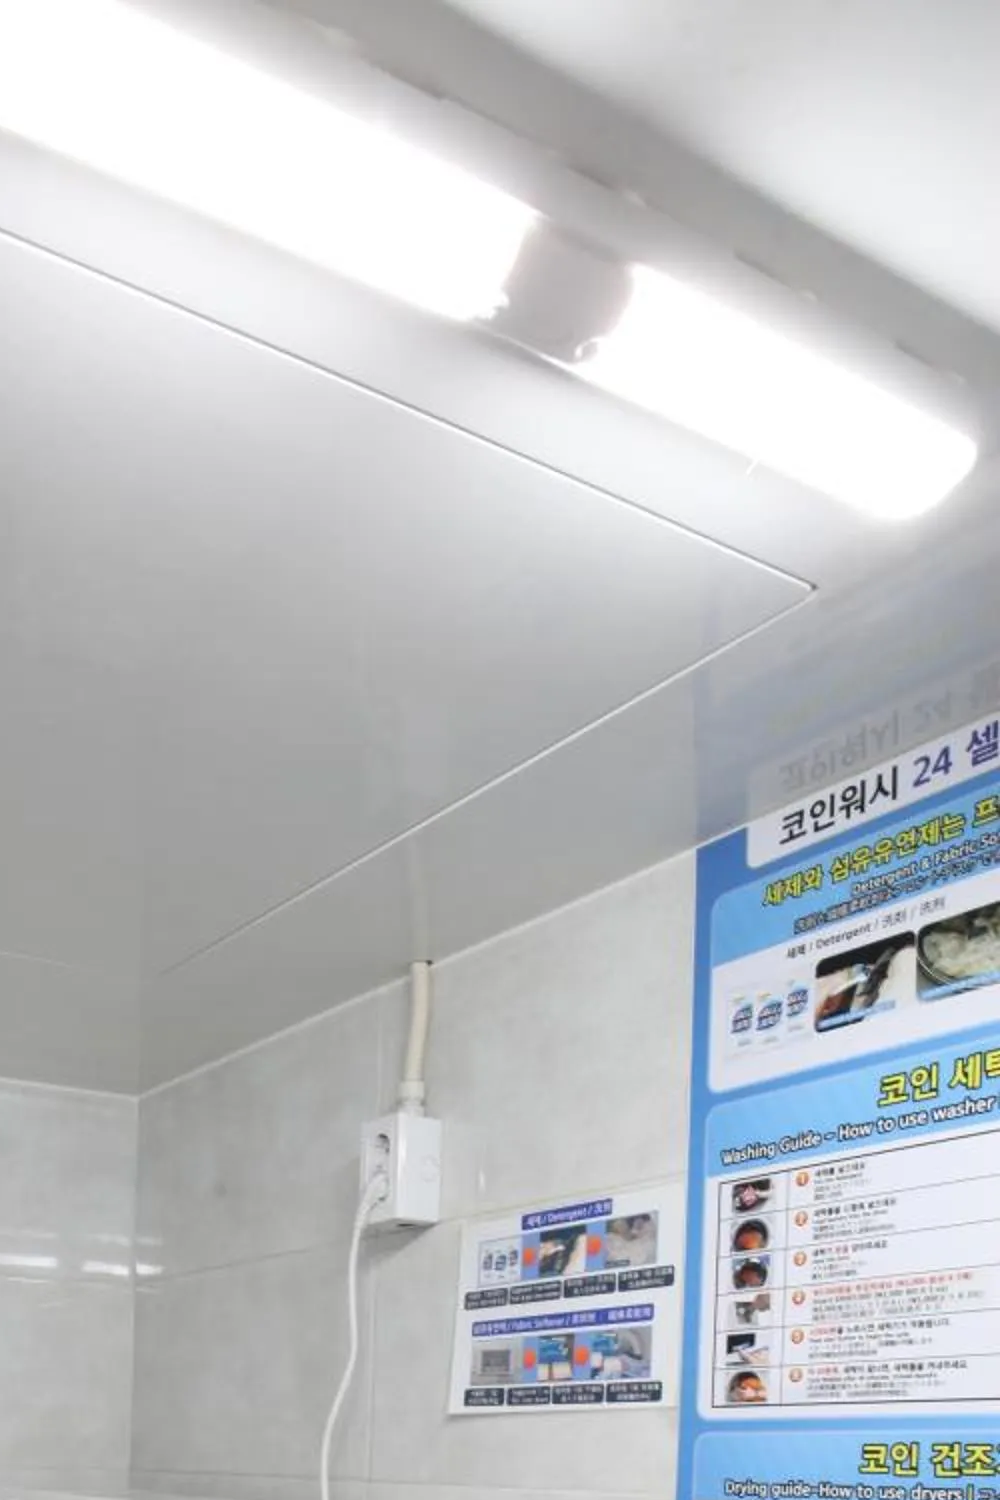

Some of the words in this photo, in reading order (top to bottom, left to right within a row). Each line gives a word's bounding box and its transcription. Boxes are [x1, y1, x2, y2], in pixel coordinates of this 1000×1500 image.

[778, 765, 899, 845] 코인워시
[913, 746, 953, 787] 24
[762, 865, 823, 907] 세제와
[831, 812, 966, 883] 섬유유연제는
[852, 863, 917, 895] Detergent
[933, 841, 977, 865] Fabric
[816, 922, 872, 949] Detergent
[876, 1061, 939, 1107] 코인
[721, 1140, 776, 1167] Washing
[779, 1130, 822, 1153] Guide
[837, 1121, 874, 1142] How
[876, 1115, 895, 1134] to
[898, 1111, 928, 1130] use
[931, 1094, 995, 1124] washer
[859, 1442, 920, 1477] 코인
[931, 1441, 1000, 1478] 건조
[724, 1479, 769, 1498] Drying
[856, 1485, 873, 1500] to
